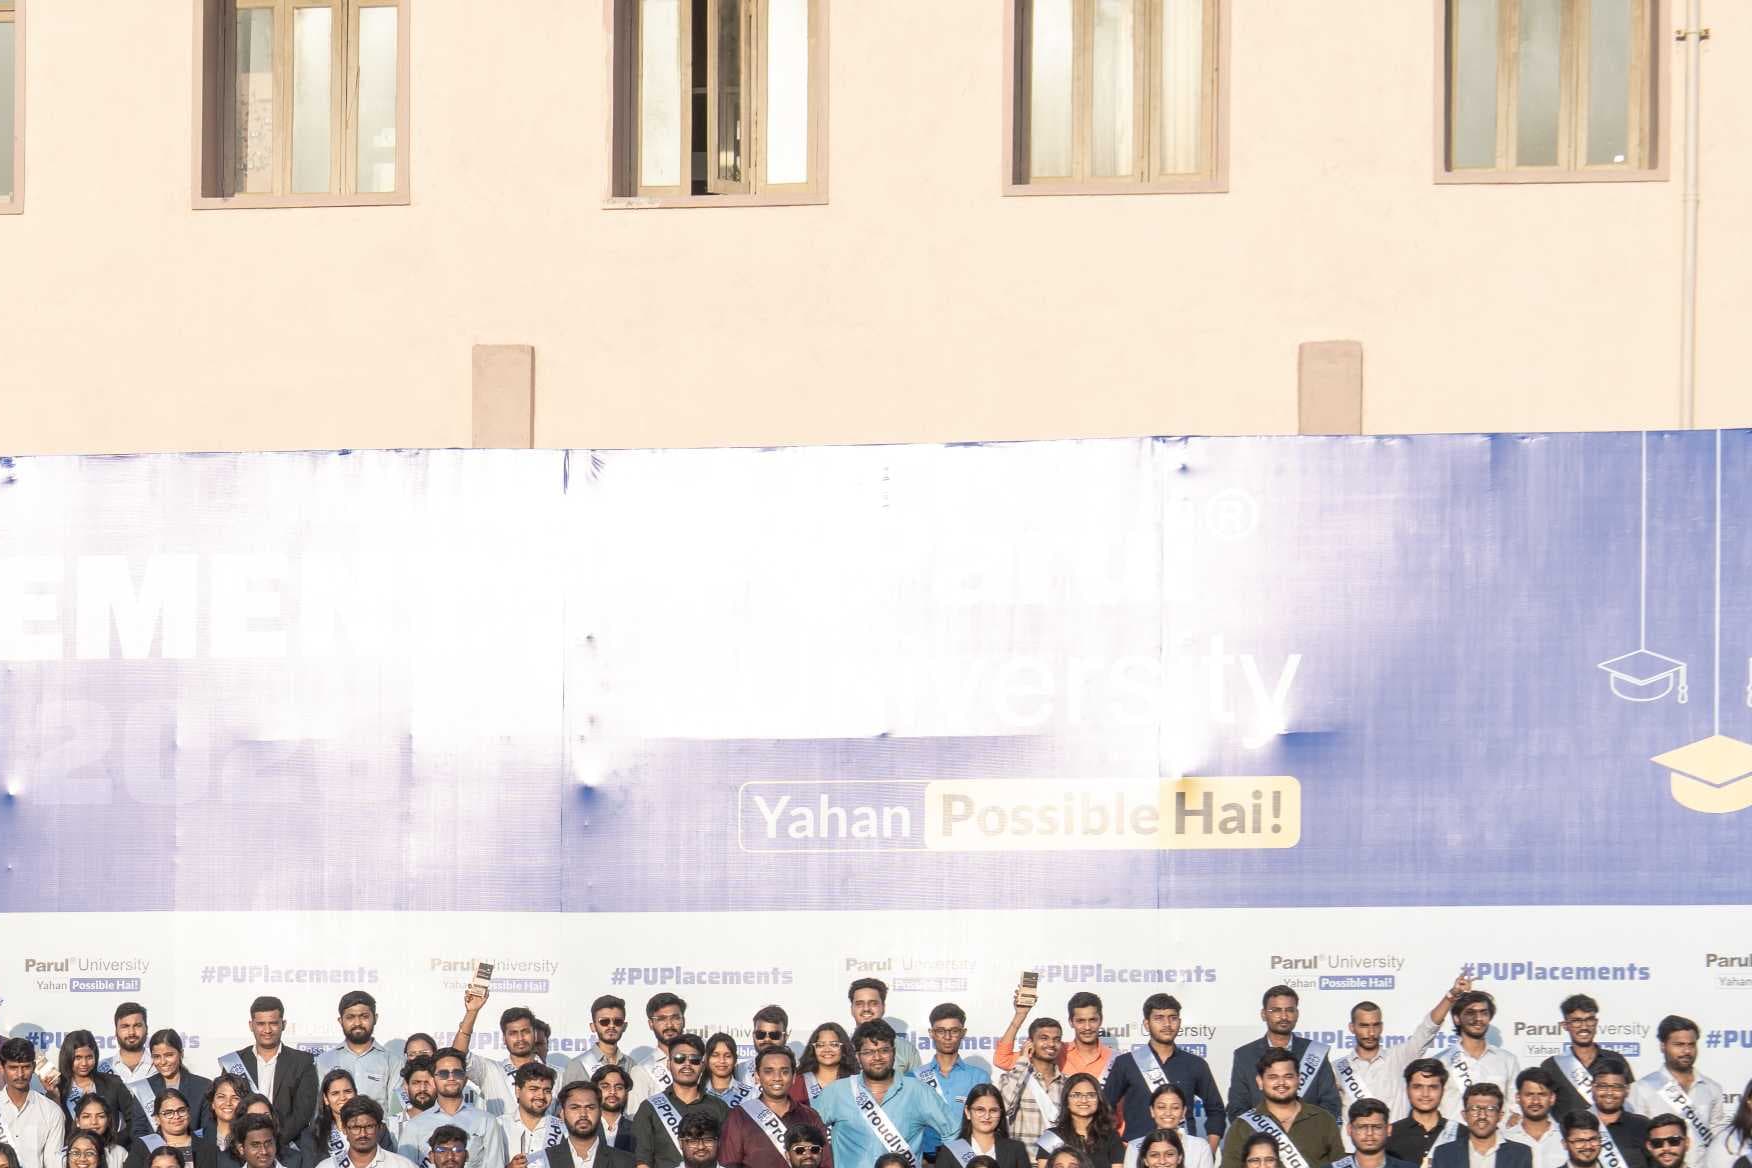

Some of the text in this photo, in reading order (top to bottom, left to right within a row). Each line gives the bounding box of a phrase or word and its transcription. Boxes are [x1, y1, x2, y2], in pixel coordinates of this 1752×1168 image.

[754, 790, 1283, 839] Yahan Possible Hai!
[78, 957, 150, 974] University
[1327, 954, 1405, 972] University
[201, 965, 379, 984] #PUPlacements
[611, 966, 794, 985] #PUPlacements
[1283, 977, 1393, 989] Yahan Possible Hai!
[36, 979, 139, 991] Yahan Possible Hai!
[1527, 1045, 1560, 1056] Yahan
